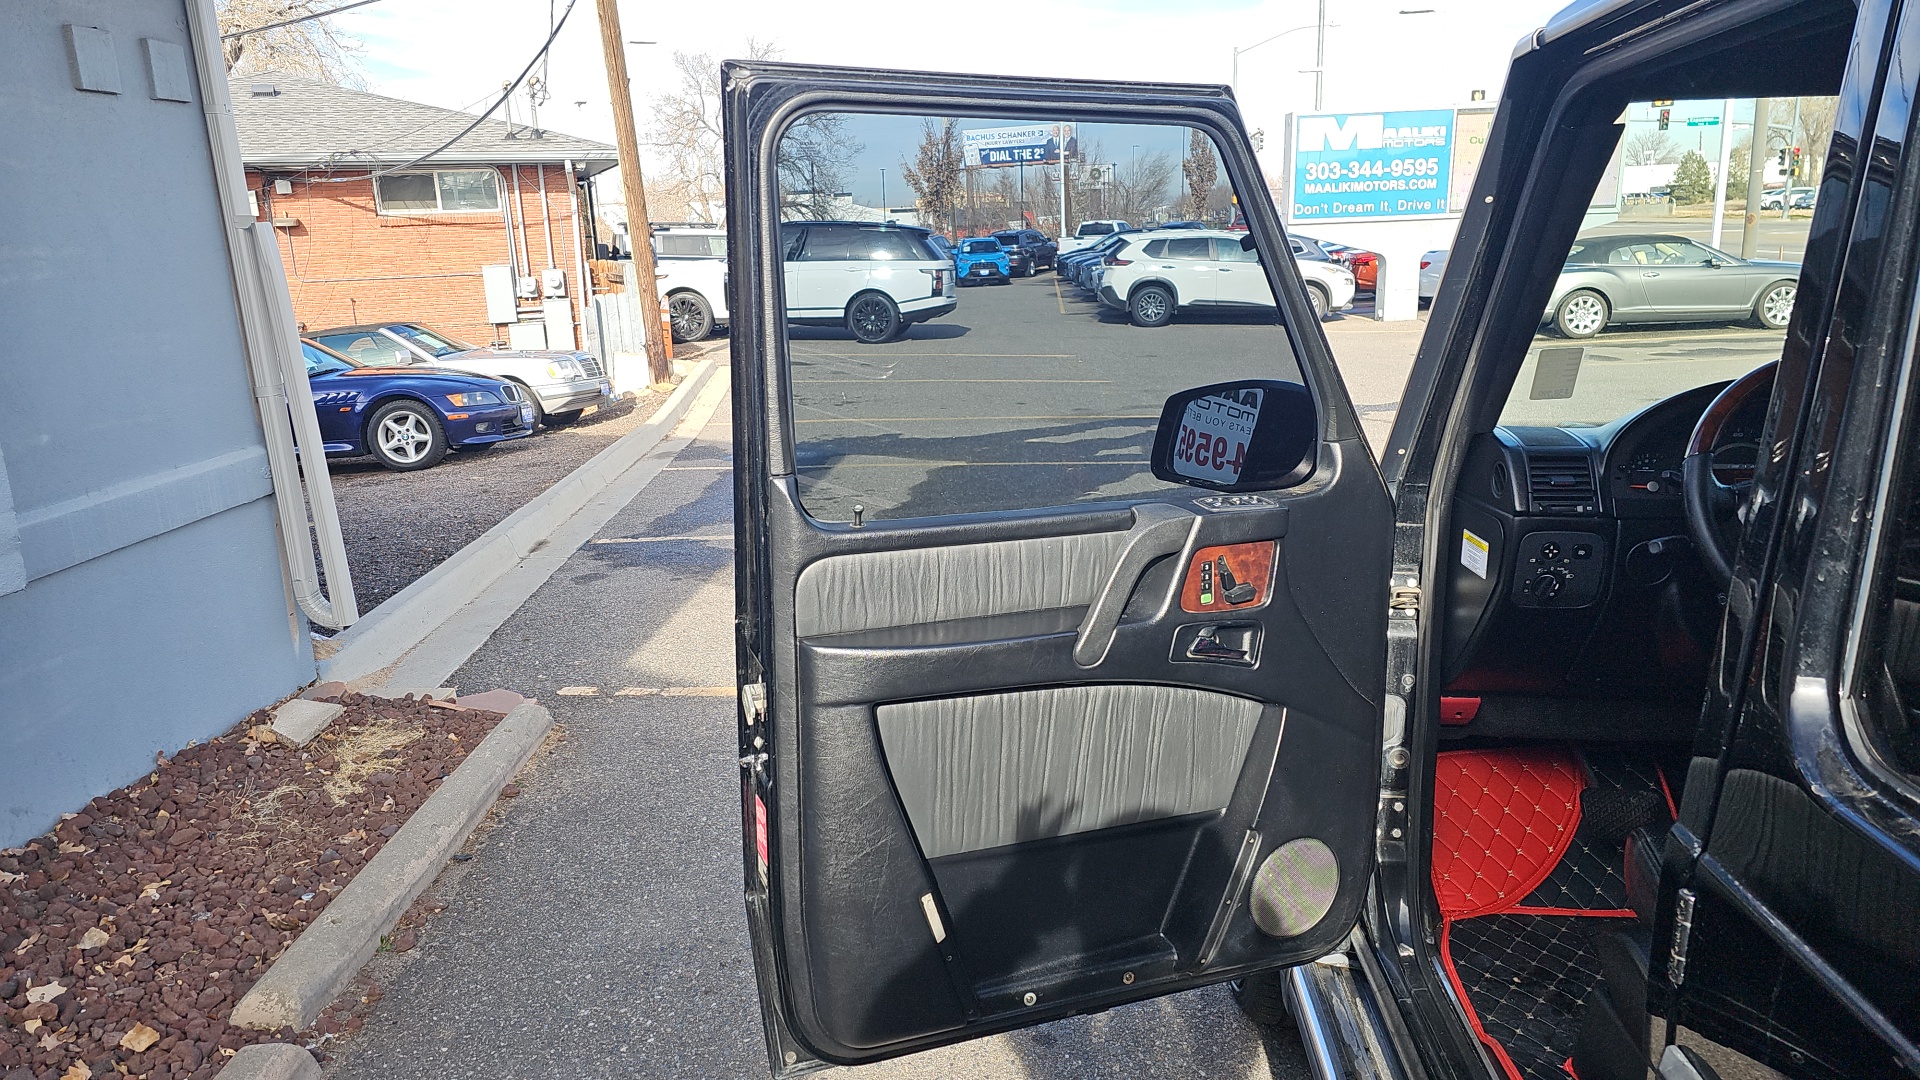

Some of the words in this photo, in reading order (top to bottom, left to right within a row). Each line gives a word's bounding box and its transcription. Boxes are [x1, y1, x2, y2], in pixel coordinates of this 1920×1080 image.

[966, 133, 995, 142] BACHUS
[997, 130, 1036, 140] SCHANKER
[1382, 138, 1446, 148] MOTORS
[989, 149, 1012, 162] DIAL
[1013, 148, 1033, 161] THE
[1305, 157, 1439, 181] 303-344-9595
[1304, 178, 1438, 194] MAALIKIMOTORS.COM
[1294, 203, 1329, 215] Don't
[1333, 202, 1375, 214] Dream
[1397, 199, 1431, 211] Drive
